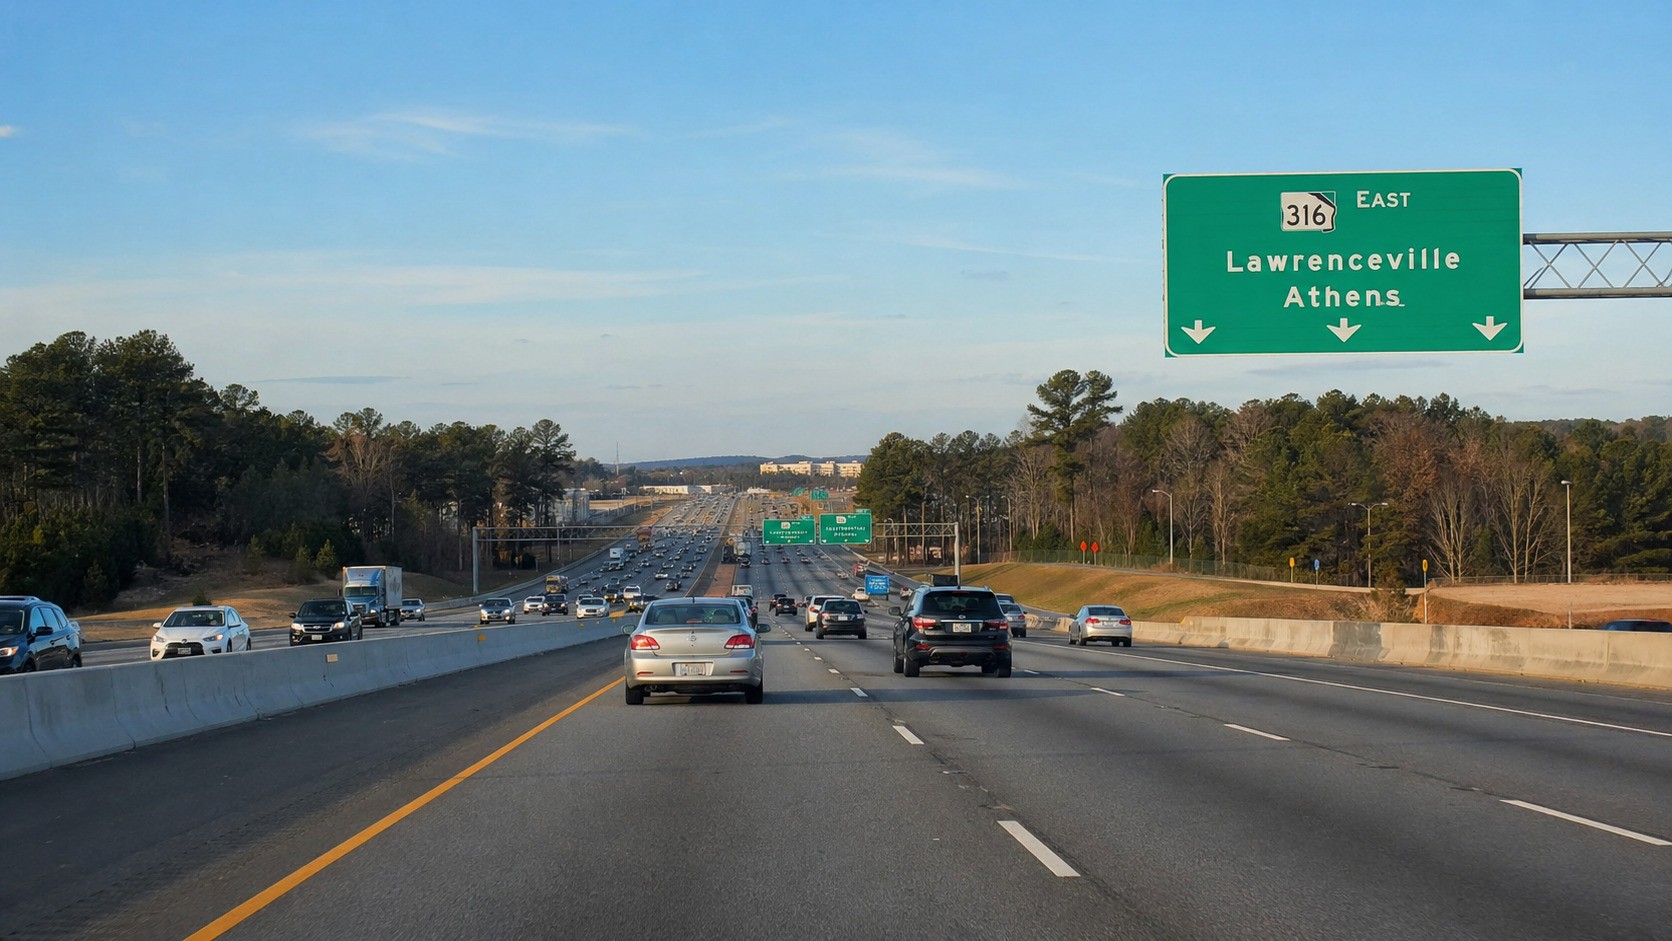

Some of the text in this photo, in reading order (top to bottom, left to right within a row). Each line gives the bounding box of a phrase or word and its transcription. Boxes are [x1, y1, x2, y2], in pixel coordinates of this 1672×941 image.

[1356, 190, 1411, 208] EAST
[1286, 204, 1327, 226] 316
[1227, 247, 1460, 273] Lawrenceville
[1283, 285, 1401, 308] Athens
